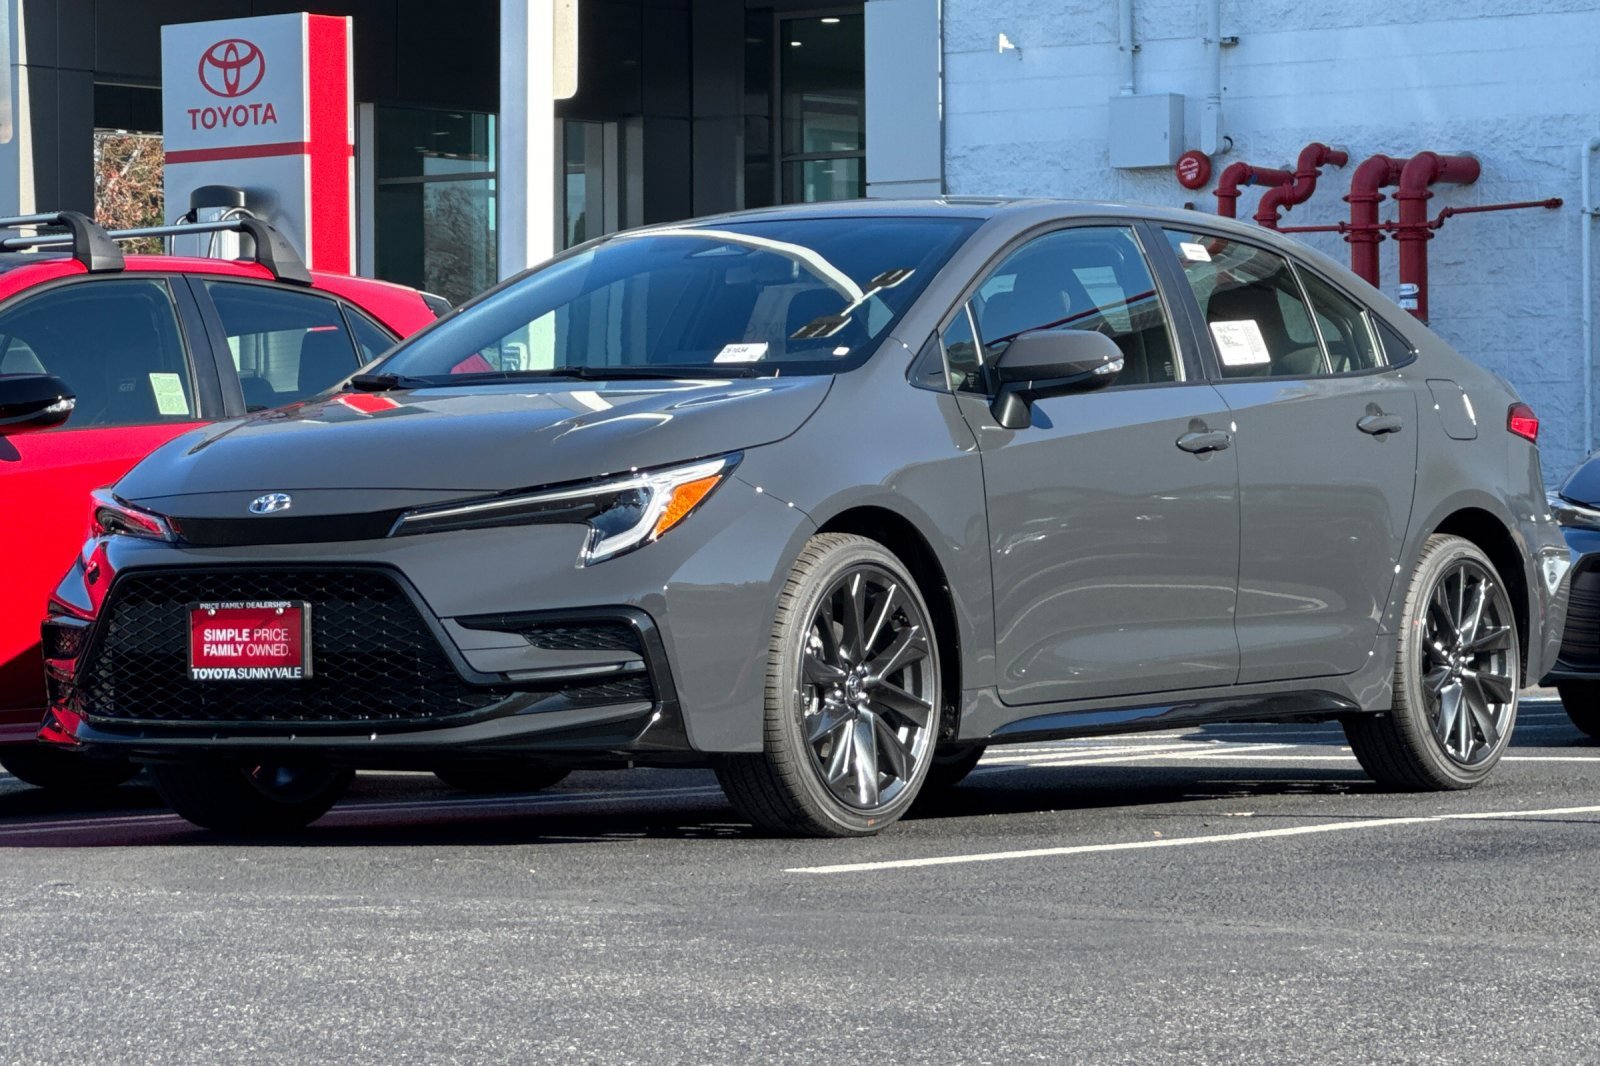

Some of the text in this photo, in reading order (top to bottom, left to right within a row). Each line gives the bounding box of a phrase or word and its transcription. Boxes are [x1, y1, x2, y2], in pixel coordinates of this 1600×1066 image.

[187, 102, 278, 130] TOYOTA
[200, 601, 292, 610] PRICE FAMILY DEALERSHIPS
[203, 628, 292, 641] SIMPLE PRICE.
[203, 643, 292, 656] FAMILY OWNED.
